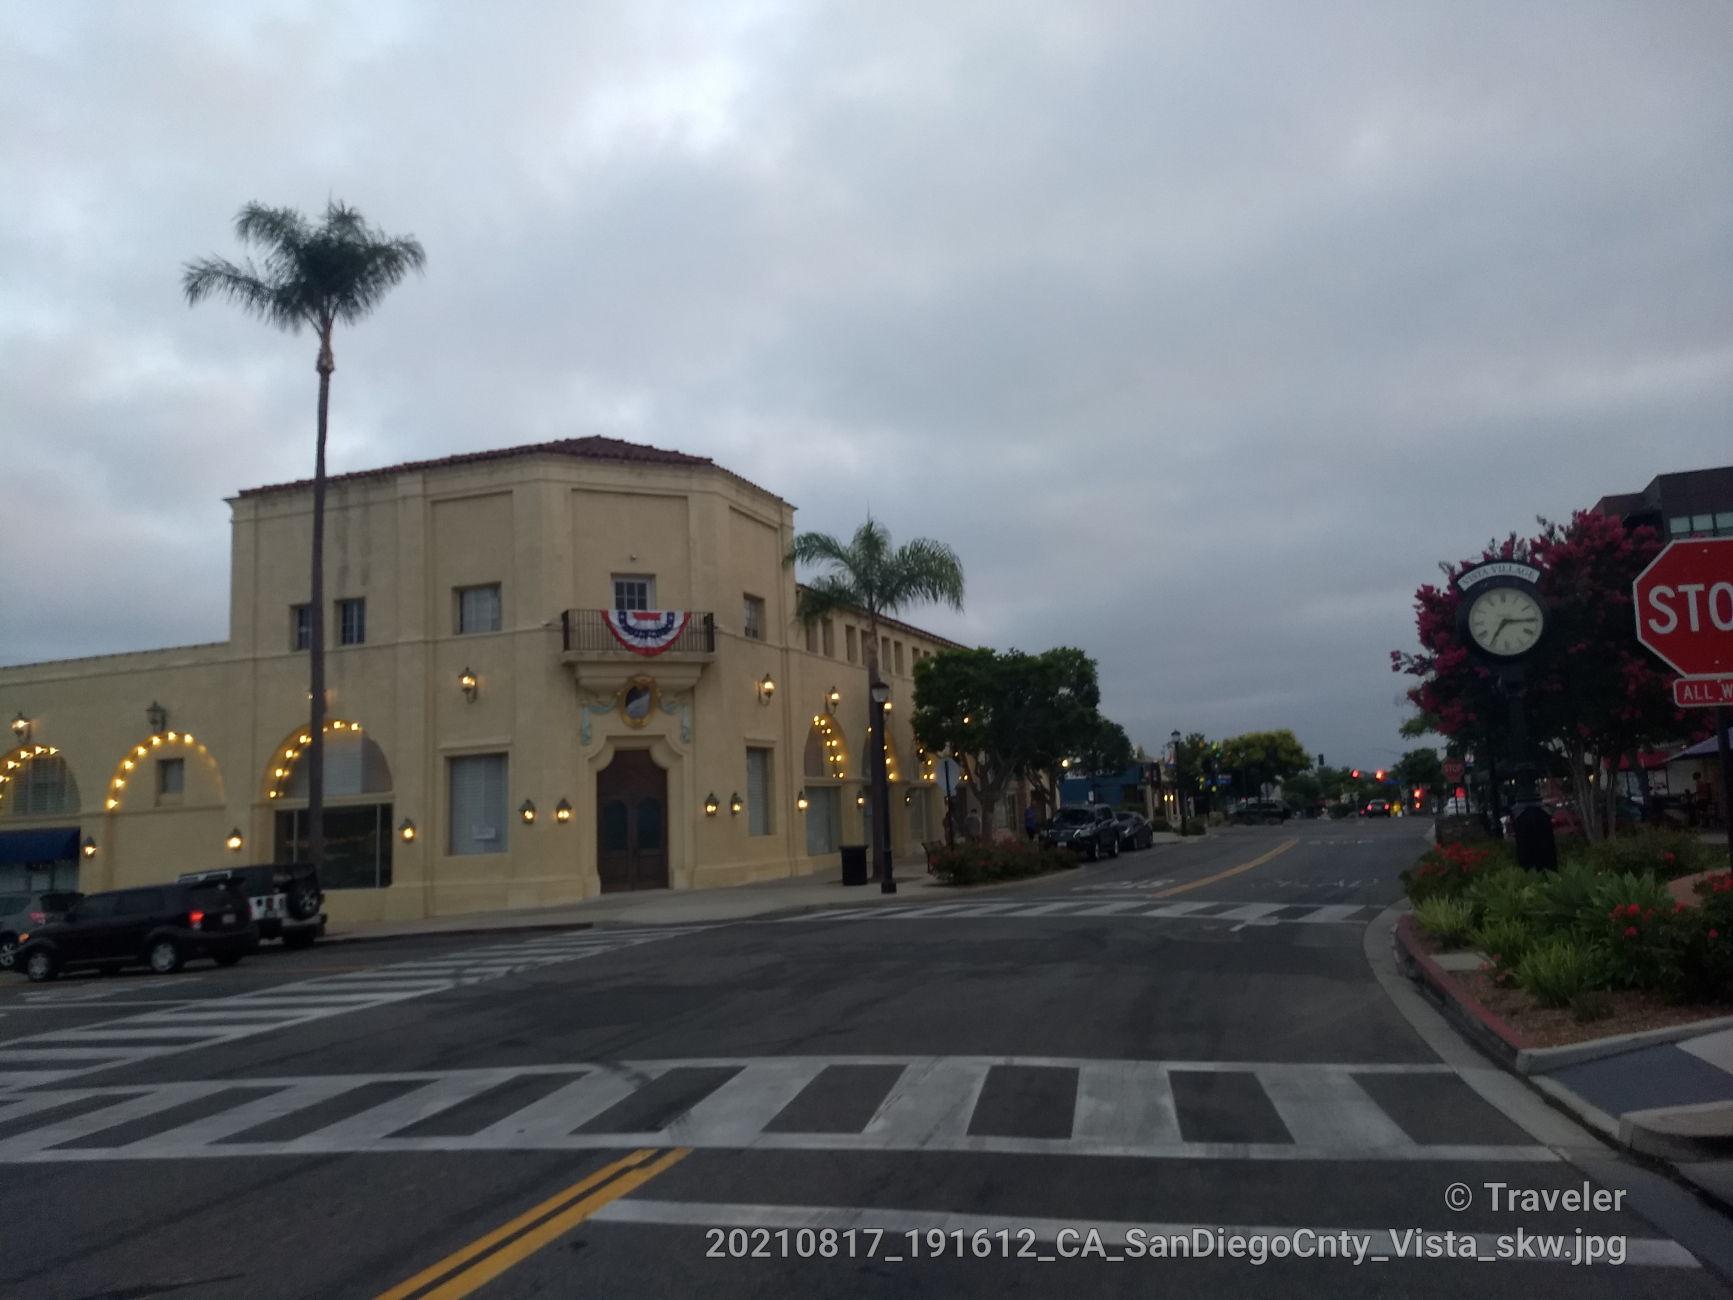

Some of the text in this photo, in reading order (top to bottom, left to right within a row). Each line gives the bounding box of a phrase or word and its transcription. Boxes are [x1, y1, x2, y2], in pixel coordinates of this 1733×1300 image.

[1461, 564, 1536, 586] VISTA VILLAGE
[1683, 684, 1713, 701] ALL
